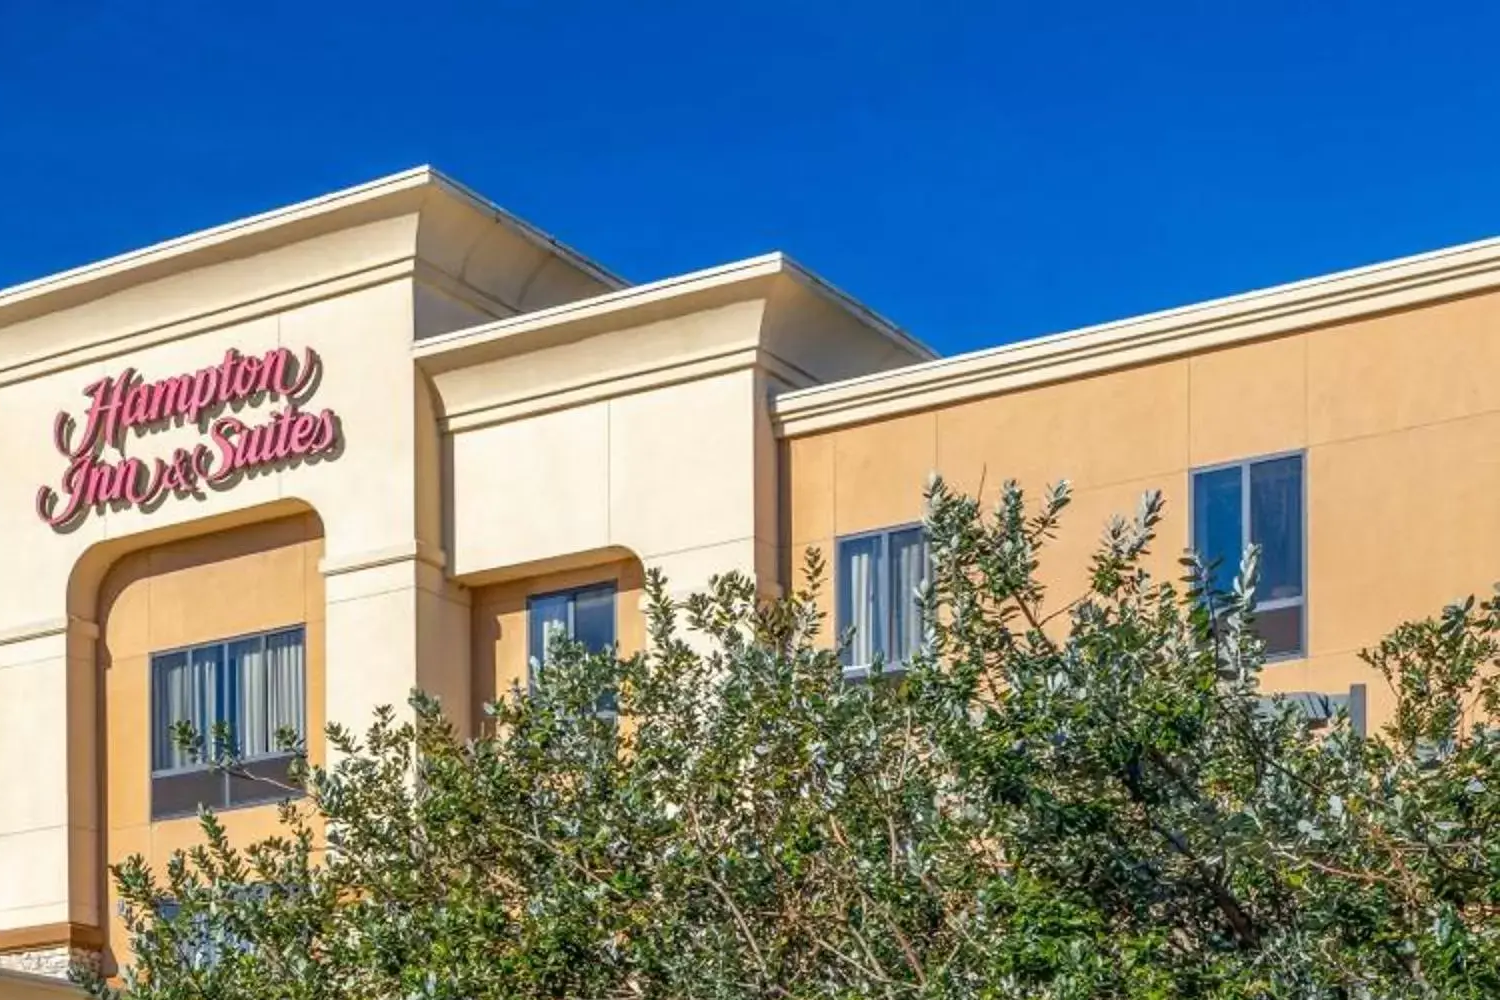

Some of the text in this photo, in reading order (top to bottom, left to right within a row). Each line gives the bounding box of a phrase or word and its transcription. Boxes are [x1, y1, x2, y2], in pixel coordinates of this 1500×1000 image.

[54, 346, 322, 460] Hampton
[36, 405, 338, 527] Inn & Suites
